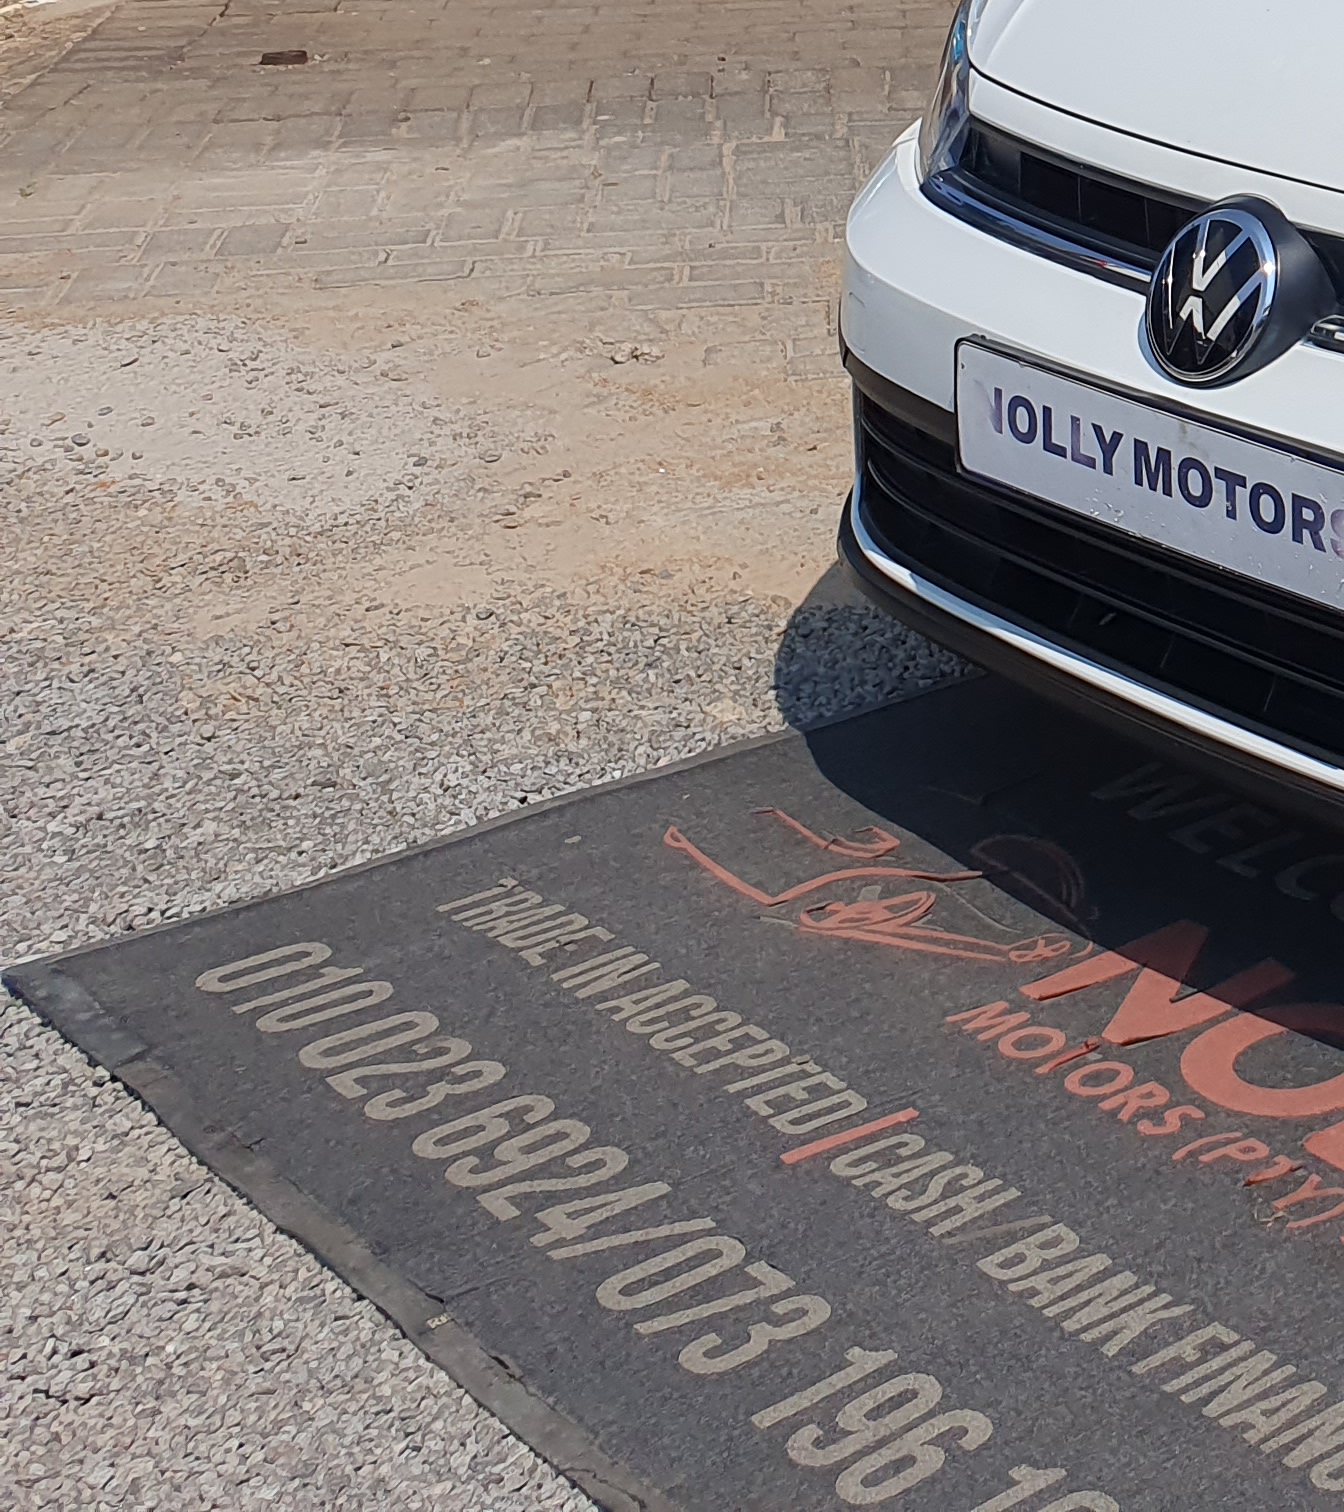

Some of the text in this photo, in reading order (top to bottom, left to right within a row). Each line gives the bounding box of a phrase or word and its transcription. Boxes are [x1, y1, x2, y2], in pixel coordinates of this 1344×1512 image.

[436, 877, 616, 967] TRADE
[550, 945, 662, 999] IN
[944, 1000, 1206, 1136] MOTORS
[194, 941, 395, 1033] 010
[298, 1010, 507, 1121] 023
[750, 1345, 995, 1505] 196
